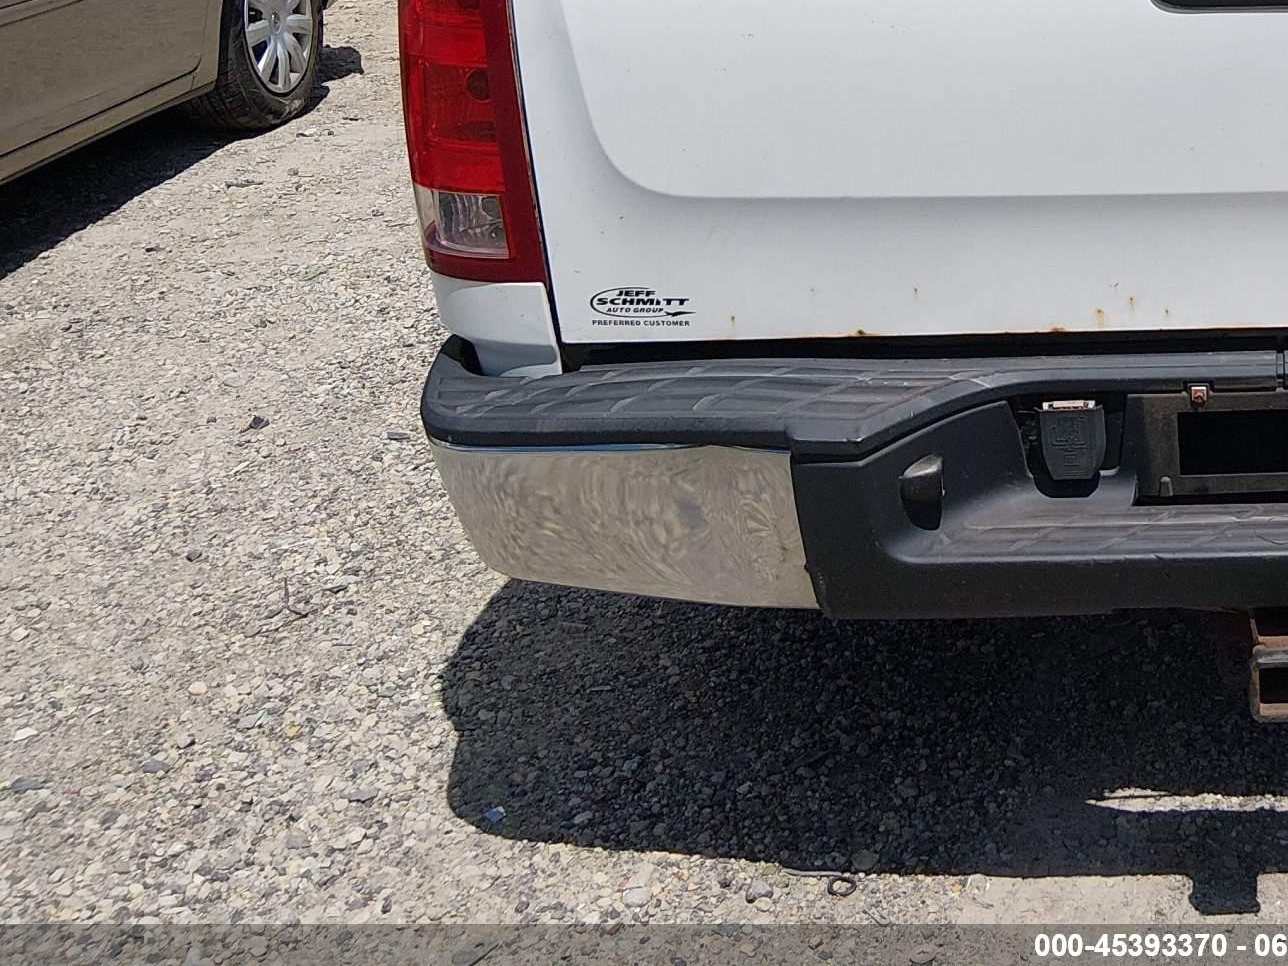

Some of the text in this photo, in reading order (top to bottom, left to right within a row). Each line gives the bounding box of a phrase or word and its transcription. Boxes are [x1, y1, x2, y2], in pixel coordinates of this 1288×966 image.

[615, 289, 657, 298] JEFF
[596, 297, 690, 306] SCHMITT
[592, 319, 641, 327] PREFERRED
